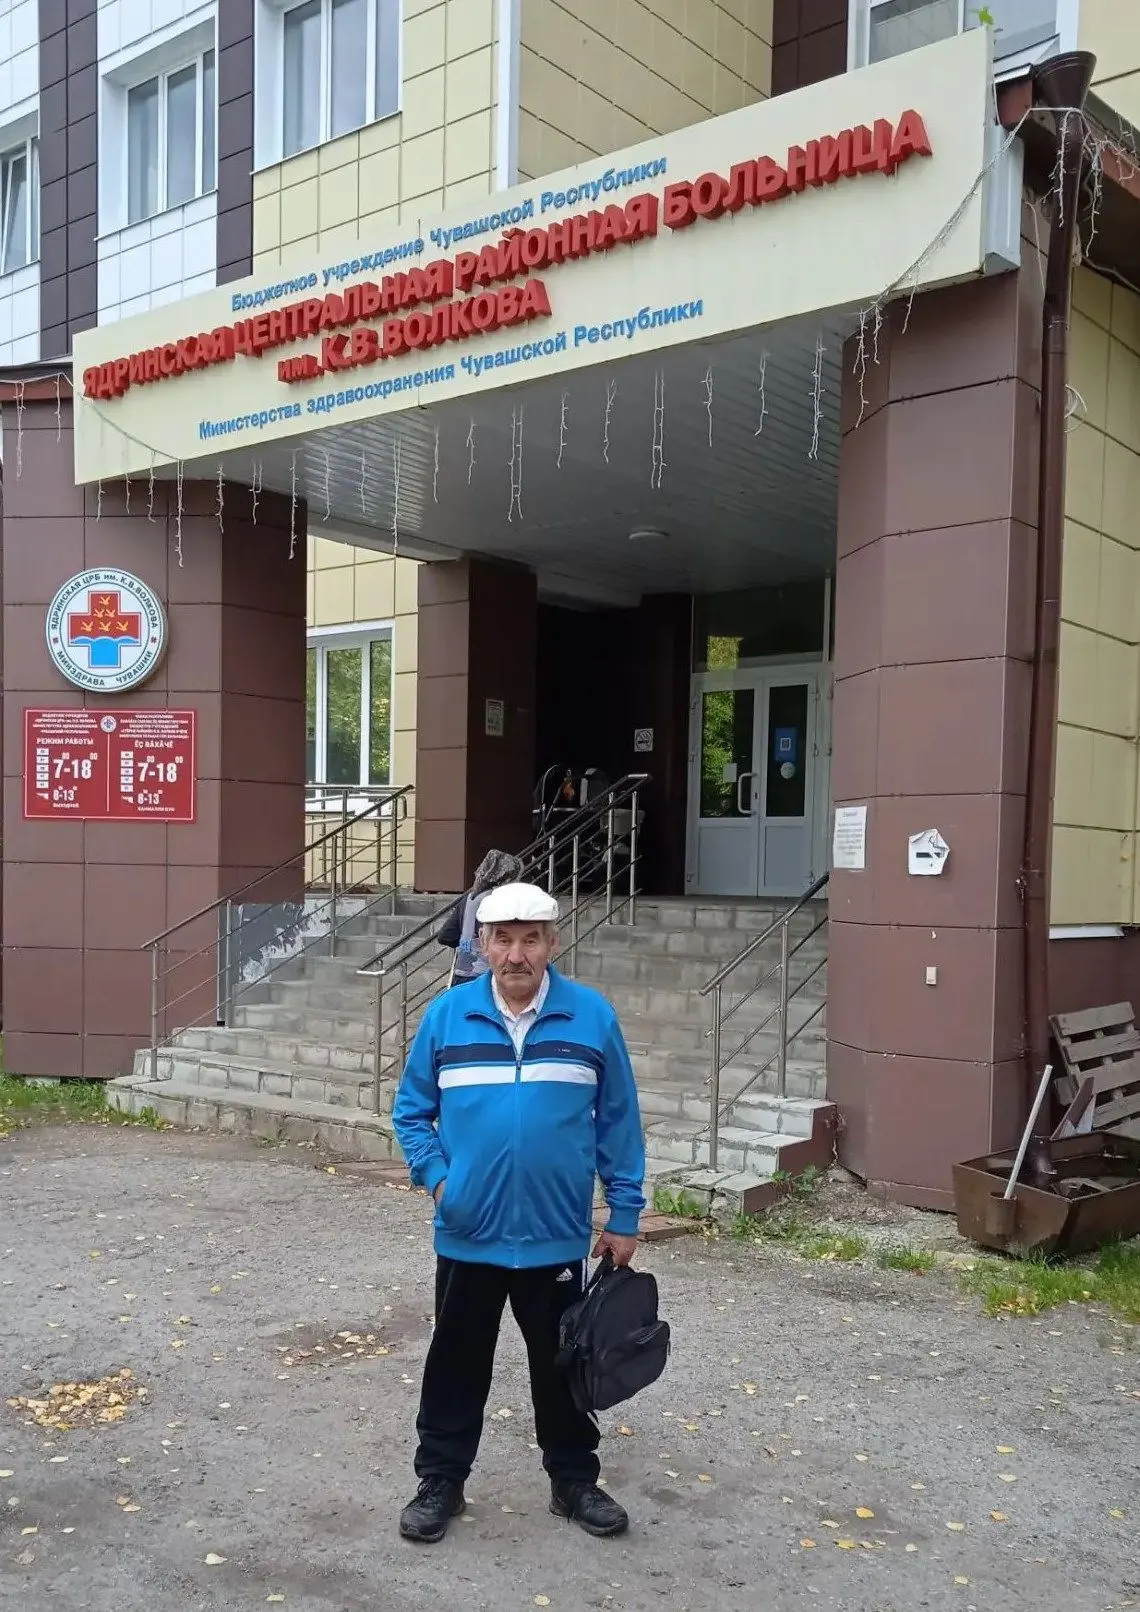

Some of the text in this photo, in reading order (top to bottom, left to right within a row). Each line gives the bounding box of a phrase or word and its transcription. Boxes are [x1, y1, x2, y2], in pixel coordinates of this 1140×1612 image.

[83, 109, 932, 400] ЯДРИНСКАЯ ЦЕНТРАЛЬНАЯ РАЙОННАЯ БОЛЬНИЦА
[231, 156, 667, 312] Бюджетное учреждение Чувашской Республики
[199, 299, 704, 441] Министерства здравоохранения Чувашской Республики
[277, 353, 323, 384] им.
[51, 582, 82, 630] ЯДРИНСКАЯ
[82, 573, 101, 585] ЦРБ
[57, 650, 153, 687] МИНЗДРАВА ЧУВАШИИ
[36, 737, 94, 745] РЕЖИМ РАБОТЫ
